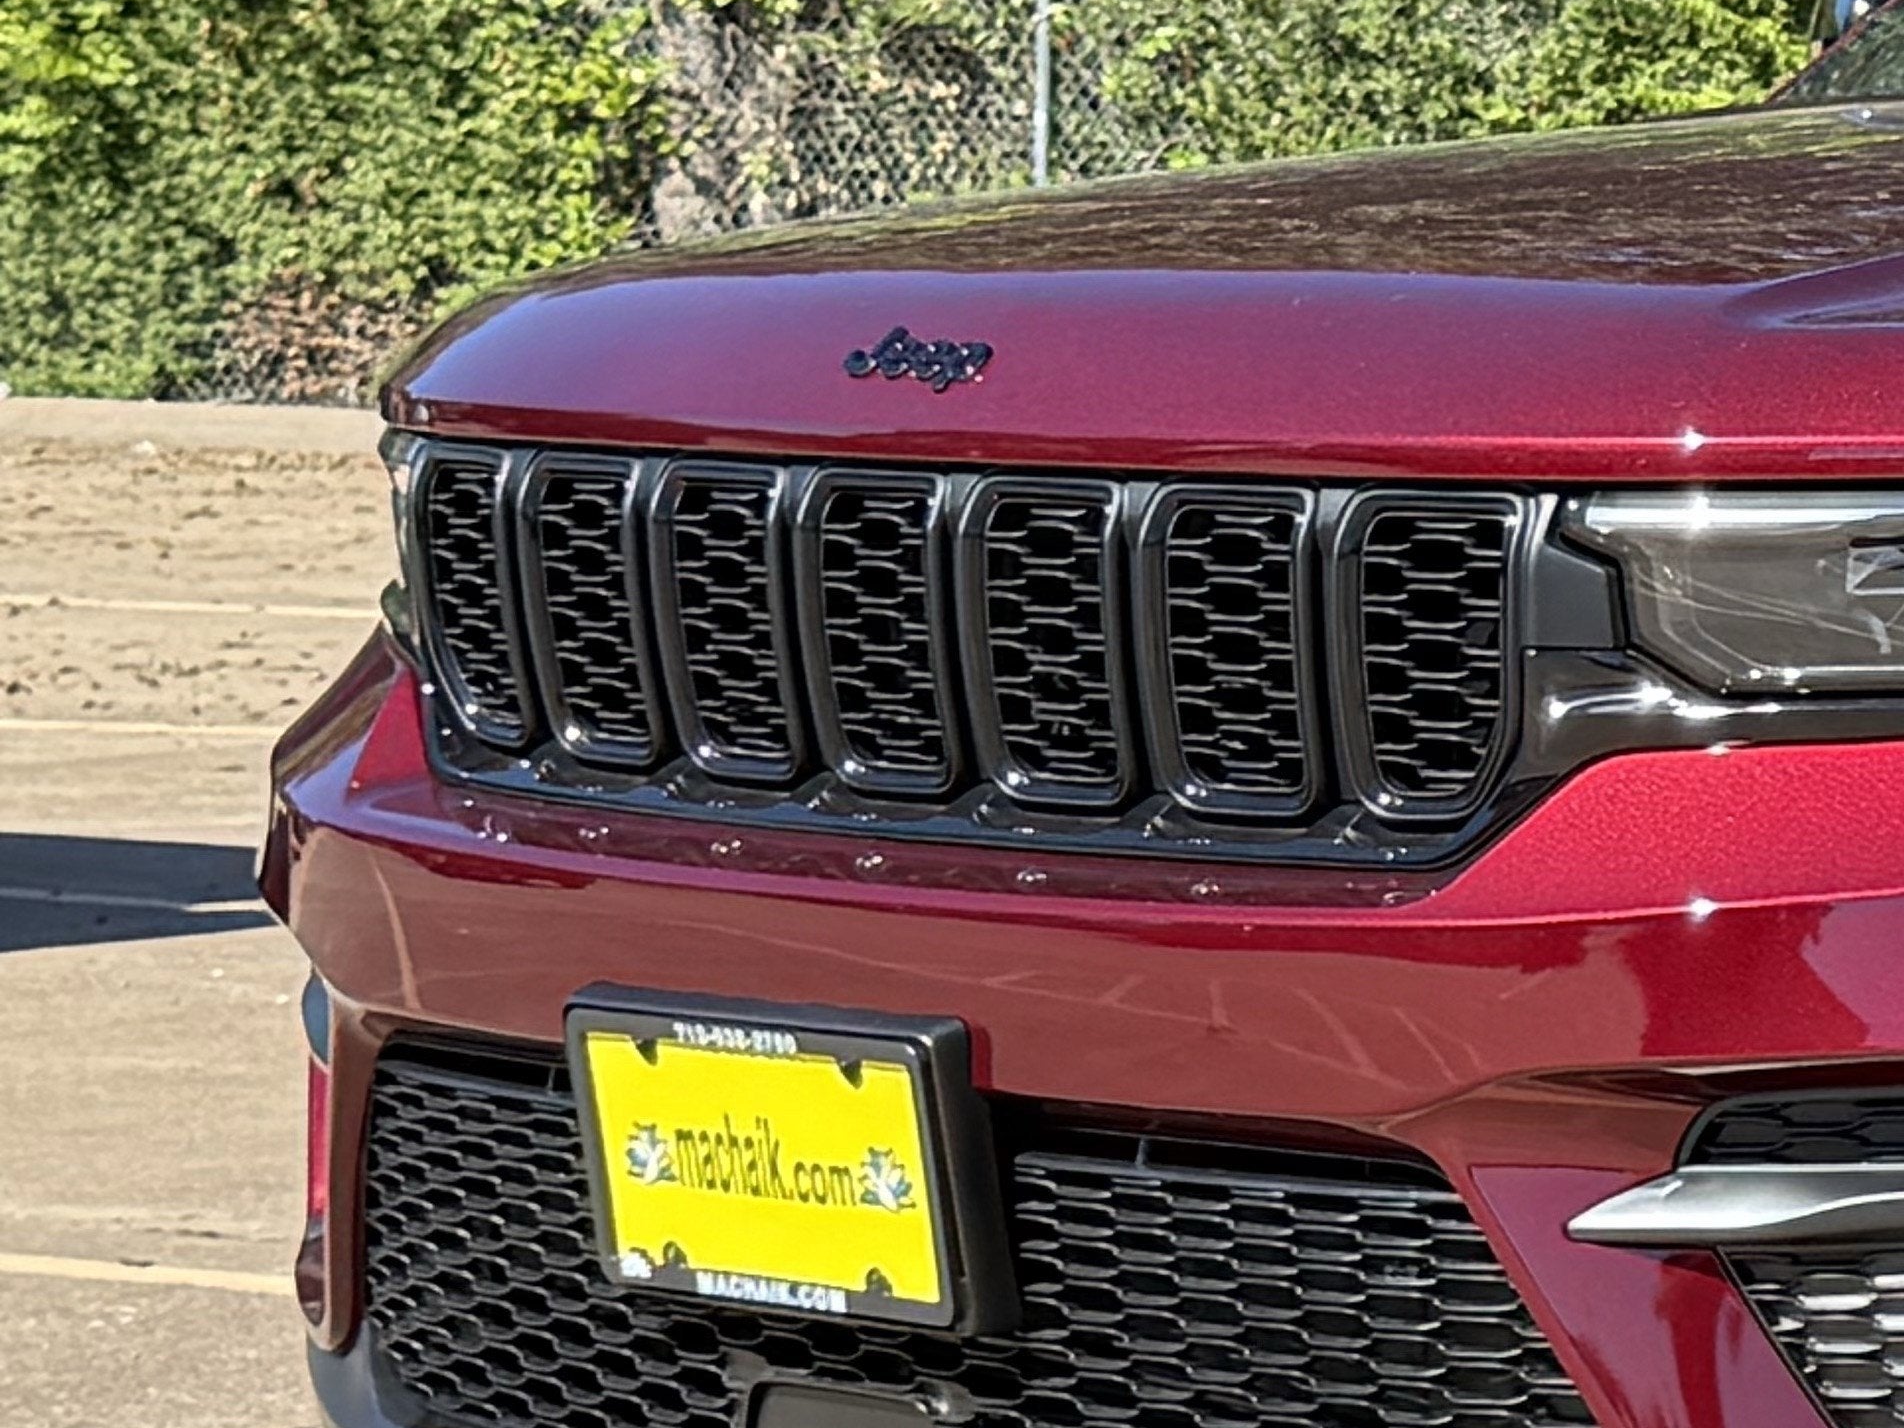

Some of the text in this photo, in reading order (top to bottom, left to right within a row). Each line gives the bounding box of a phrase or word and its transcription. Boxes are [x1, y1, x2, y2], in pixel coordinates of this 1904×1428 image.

[843, 326, 994, 394] Jeep
[674, 1112, 859, 1208] machaik.com
[695, 1270, 849, 1314] MACHAIK.COM
